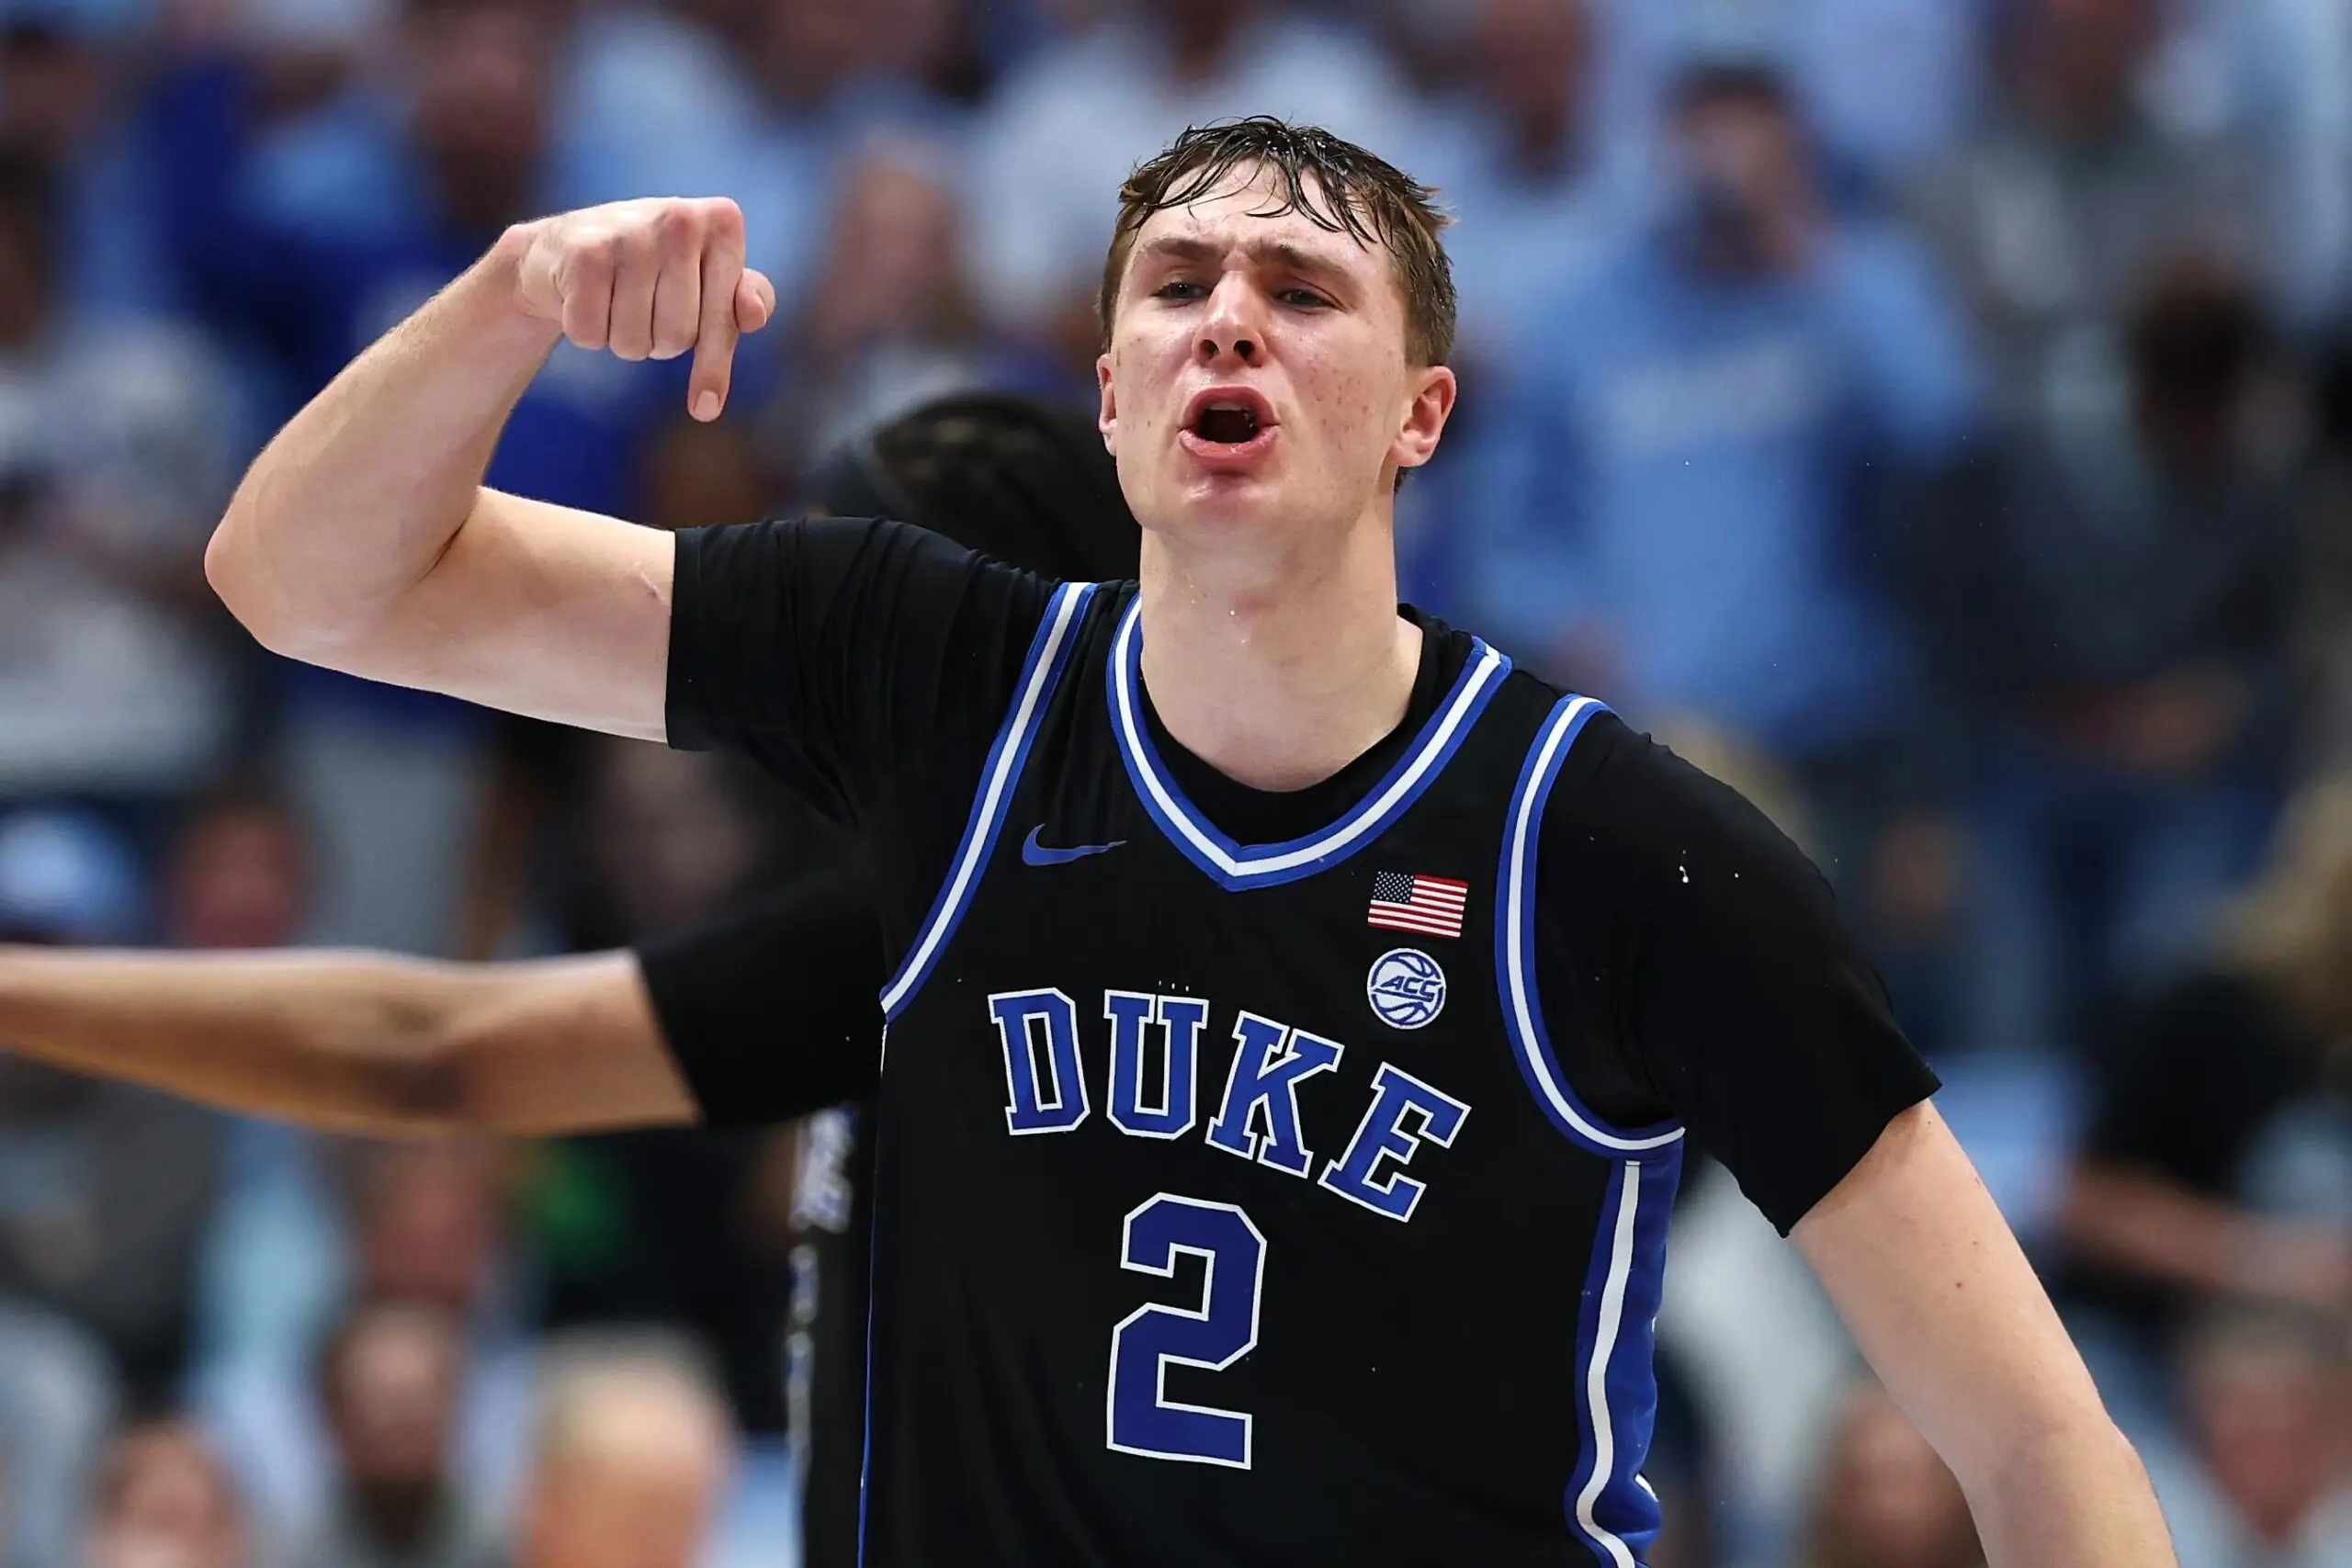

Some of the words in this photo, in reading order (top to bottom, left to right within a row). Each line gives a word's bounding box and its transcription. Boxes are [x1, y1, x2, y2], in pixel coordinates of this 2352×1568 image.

[988, 987, 1471, 1223] DUKE
[1380, 976, 1442, 1001] ACC
[1106, 1192, 1267, 1470] 2
